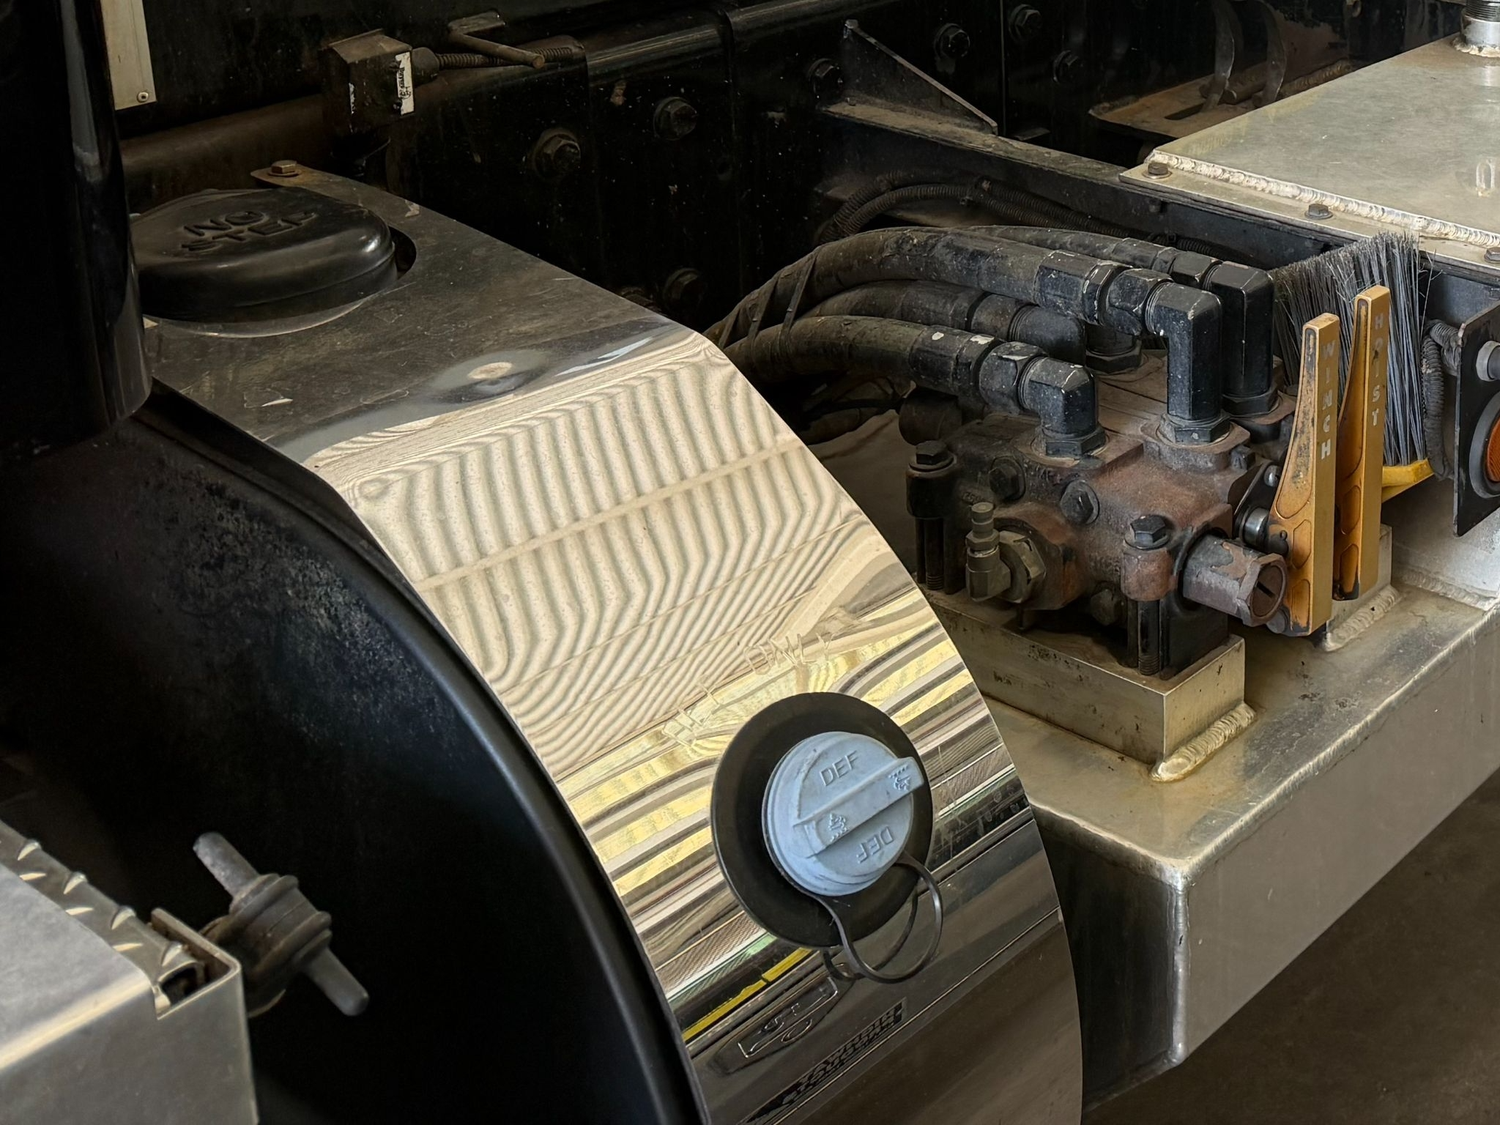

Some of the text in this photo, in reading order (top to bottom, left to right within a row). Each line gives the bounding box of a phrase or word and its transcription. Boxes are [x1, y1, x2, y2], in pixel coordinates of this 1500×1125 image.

[181, 212, 310, 250] STEP
[183, 211, 265, 237] NO
[1371, 312, 1385, 427] HOIST
[1320, 339, 1337, 460] WINCH
[818, 750, 860, 787] DEF
[855, 826, 896, 864] DEF
